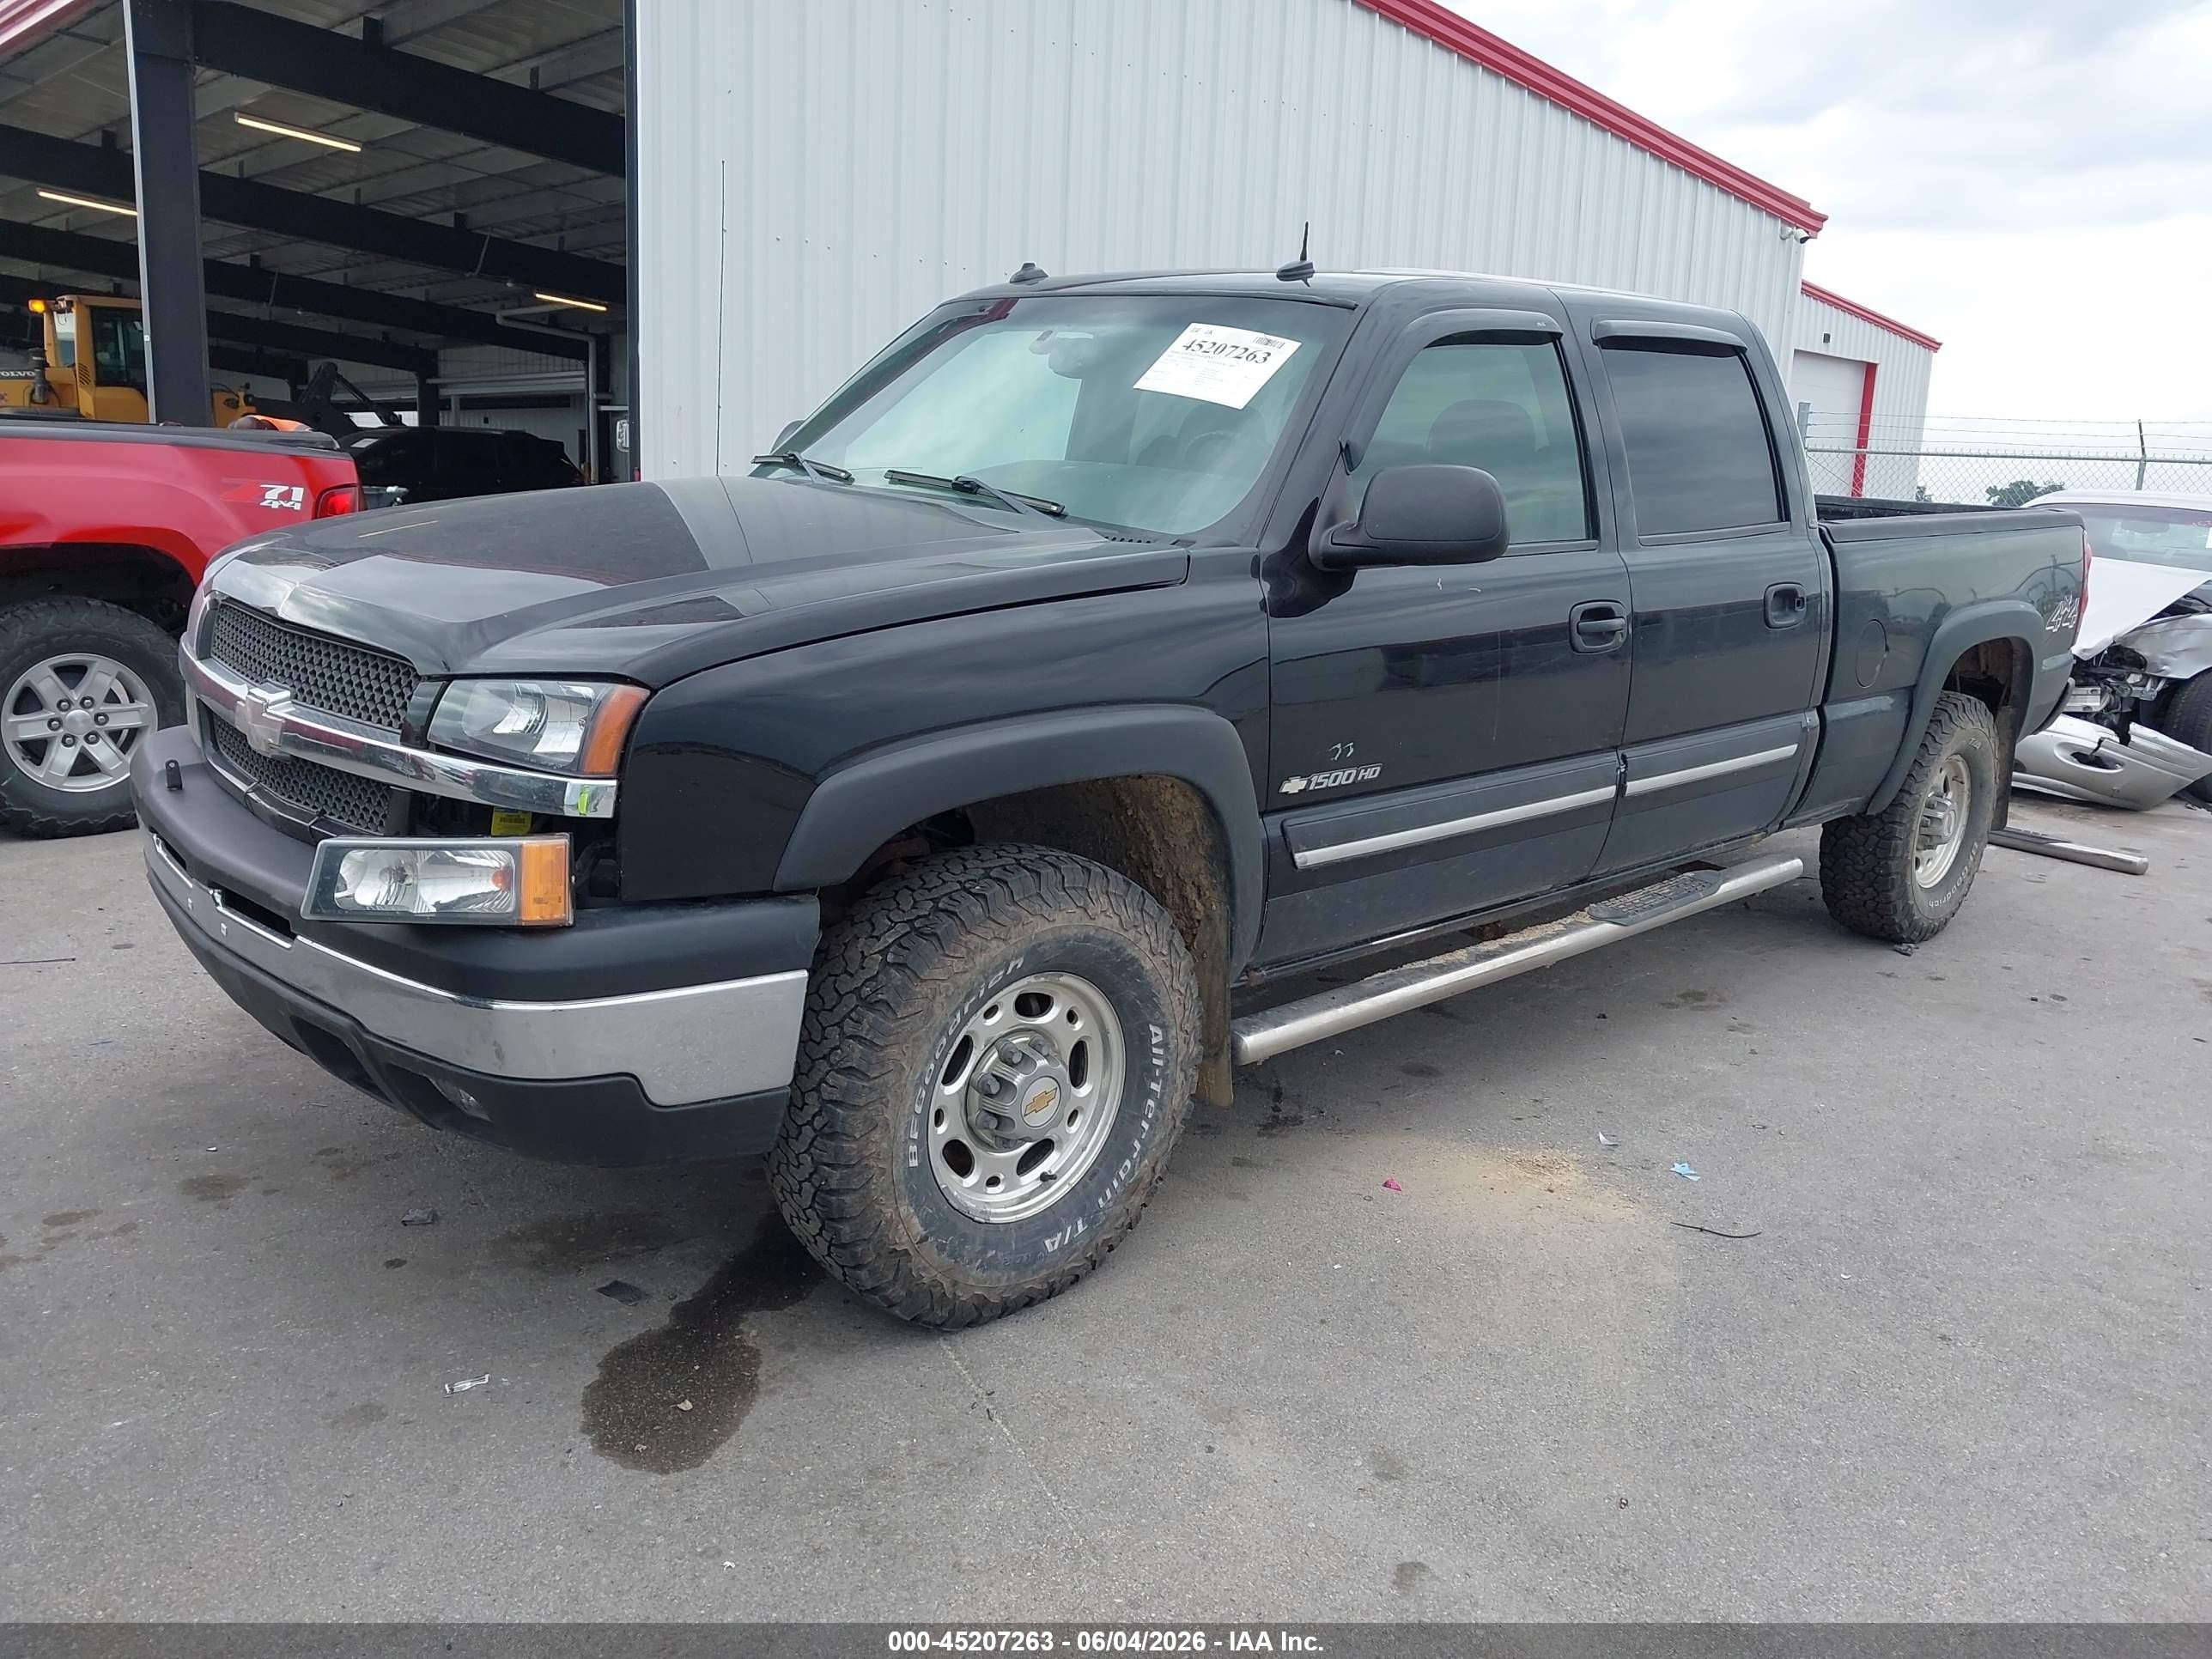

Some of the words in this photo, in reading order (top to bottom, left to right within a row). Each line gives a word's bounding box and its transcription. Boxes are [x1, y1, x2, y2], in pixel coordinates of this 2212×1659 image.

[1183, 338, 1272, 364] 45207263
[1309, 769, 1358, 791] 1500
[1358, 764, 1382, 781] HD
[1043, 1216, 1088, 1254] T/A
